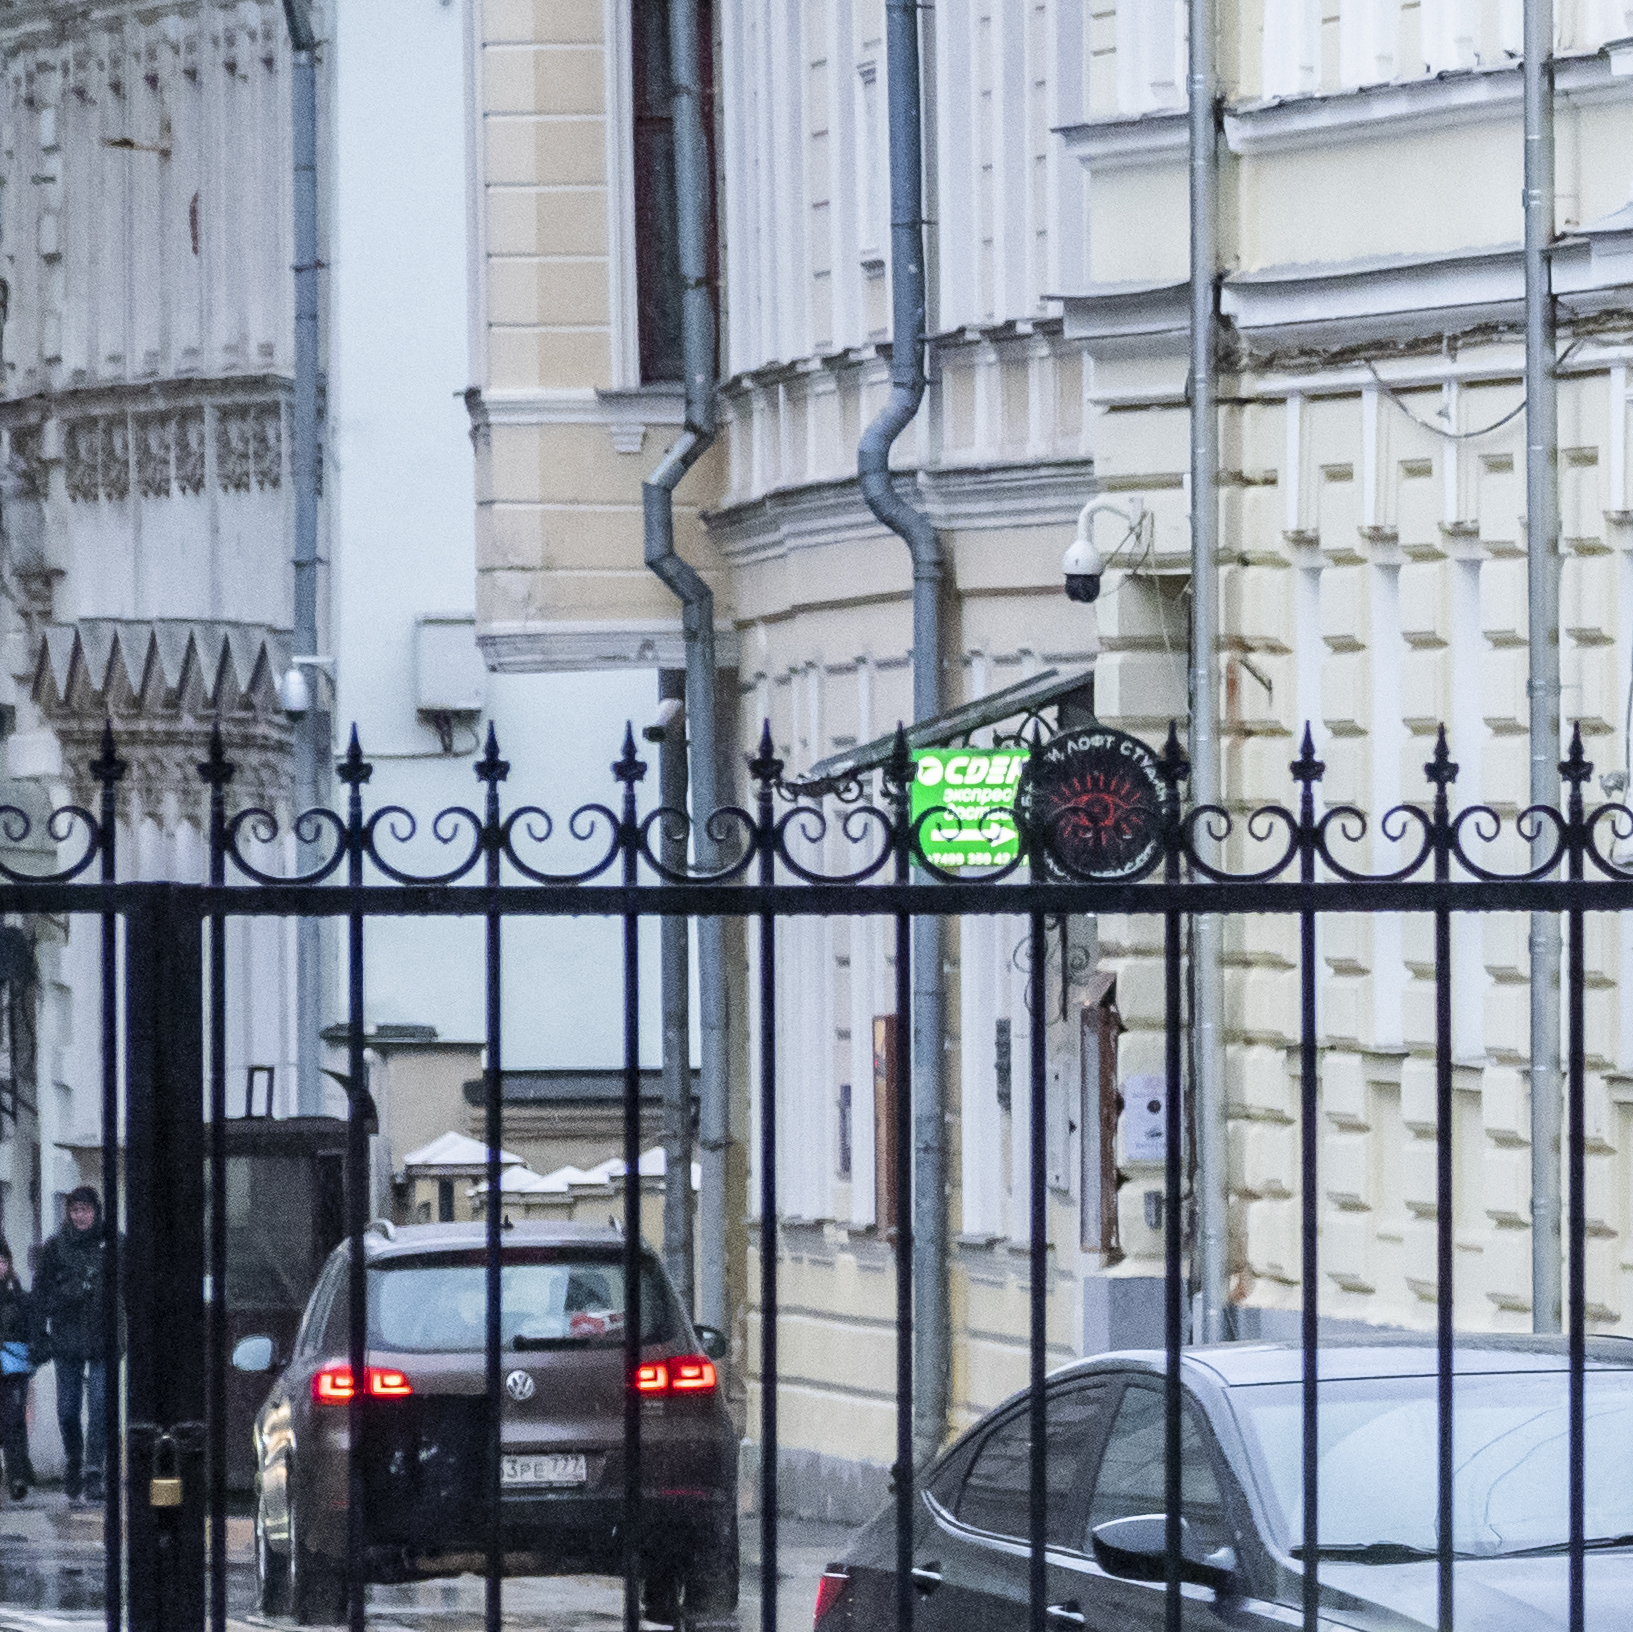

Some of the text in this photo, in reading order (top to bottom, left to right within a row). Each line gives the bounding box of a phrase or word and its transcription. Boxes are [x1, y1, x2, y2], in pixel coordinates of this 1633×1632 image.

[1066, 735, 1116, 754] ЛОФТ
[942, 787, 1014, 806] экспрес
[501, 1459, 546, 1479] 3PE
